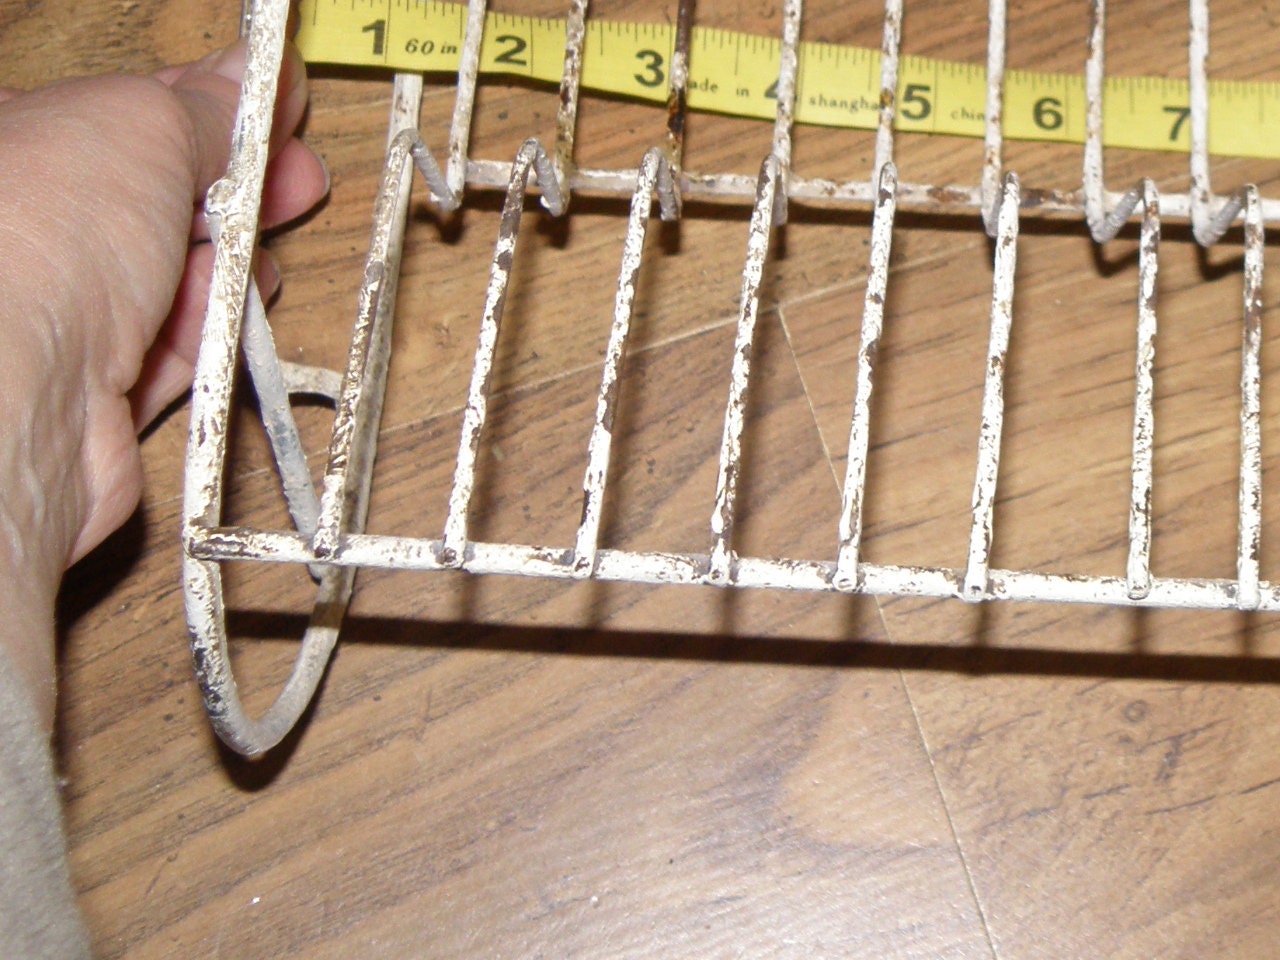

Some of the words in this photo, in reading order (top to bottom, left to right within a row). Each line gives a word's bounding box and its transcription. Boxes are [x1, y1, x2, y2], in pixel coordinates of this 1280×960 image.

[361, 18, 386, 56] 1
[404, 39, 435, 56] 60
[440, 41, 459, 55] in
[493, 34, 529, 67] 2
[633, 49, 666, 88] 3
[687, 78, 719, 93] ade
[735, 86, 750, 98] in
[808, 92, 885, 112] shangha
[950, 107, 988, 122] chin
[901, 83, 932, 121] 5
[1032, 97, 1064, 131] 6
[1162, 106, 1192, 141] 7
